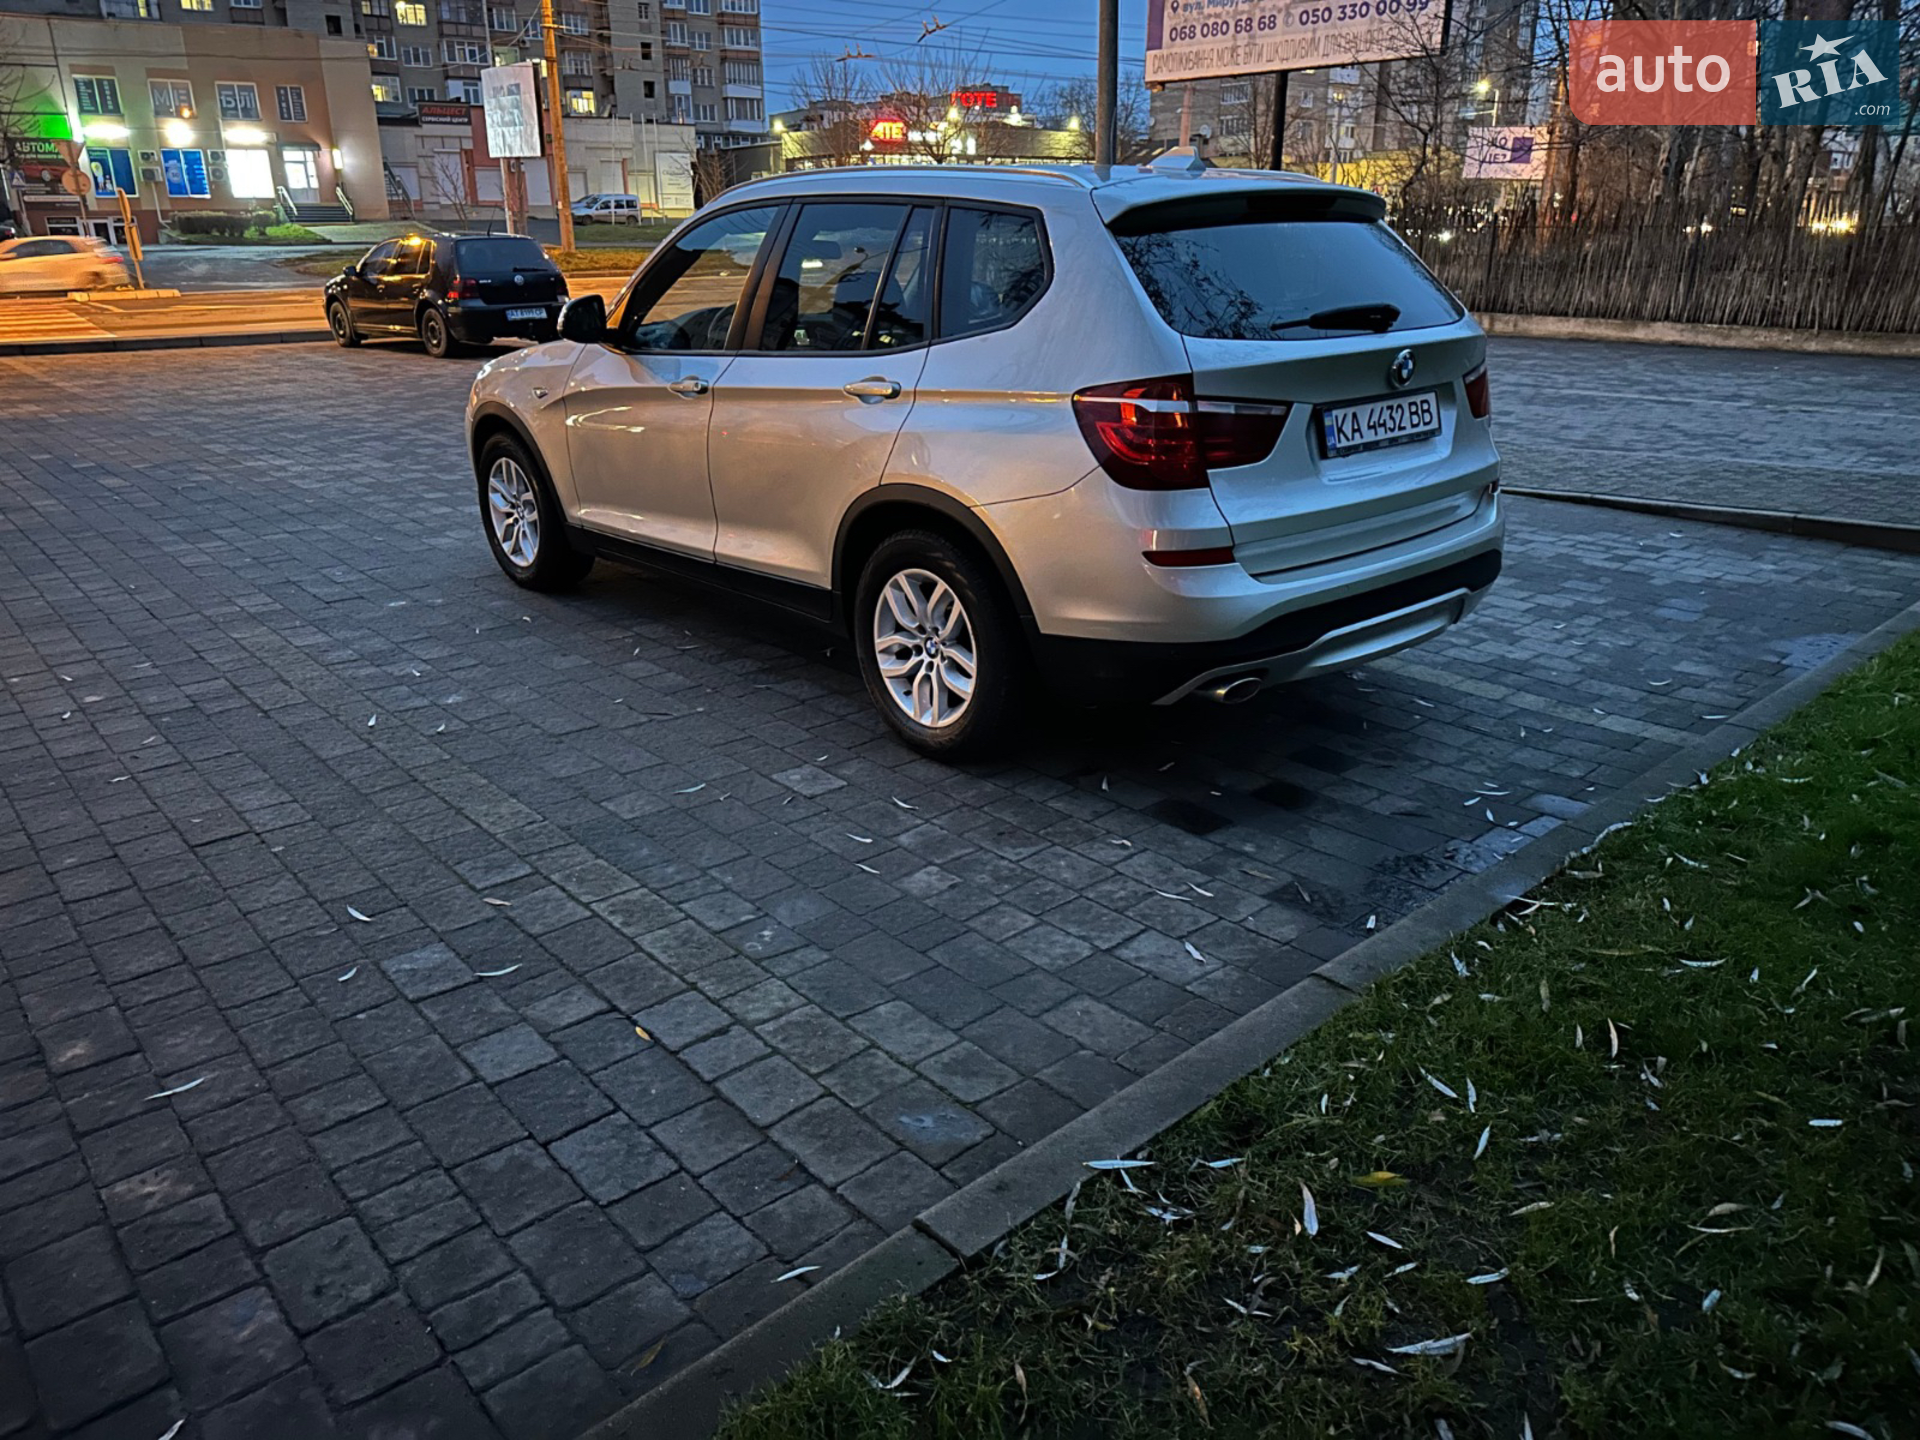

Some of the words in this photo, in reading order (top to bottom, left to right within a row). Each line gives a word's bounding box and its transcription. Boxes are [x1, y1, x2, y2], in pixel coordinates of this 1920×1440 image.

[1169, 24, 1197, 42] 068
[1200, 20, 1230, 38] 080
[1234, 17, 1254, 34] 68
[1257, 14, 1277, 31] 68
[1299, 7, 1332, 26] 050
[1337, 1, 1370, 21] 330
[1375, 0, 1400, 16] 00
[421, 106, 467, 115] АЛЬЦЕСТ
[1334, 411, 1364, 443] KA
[1367, 403, 1407, 437] 4432
[1408, 399, 1434, 429] BB
